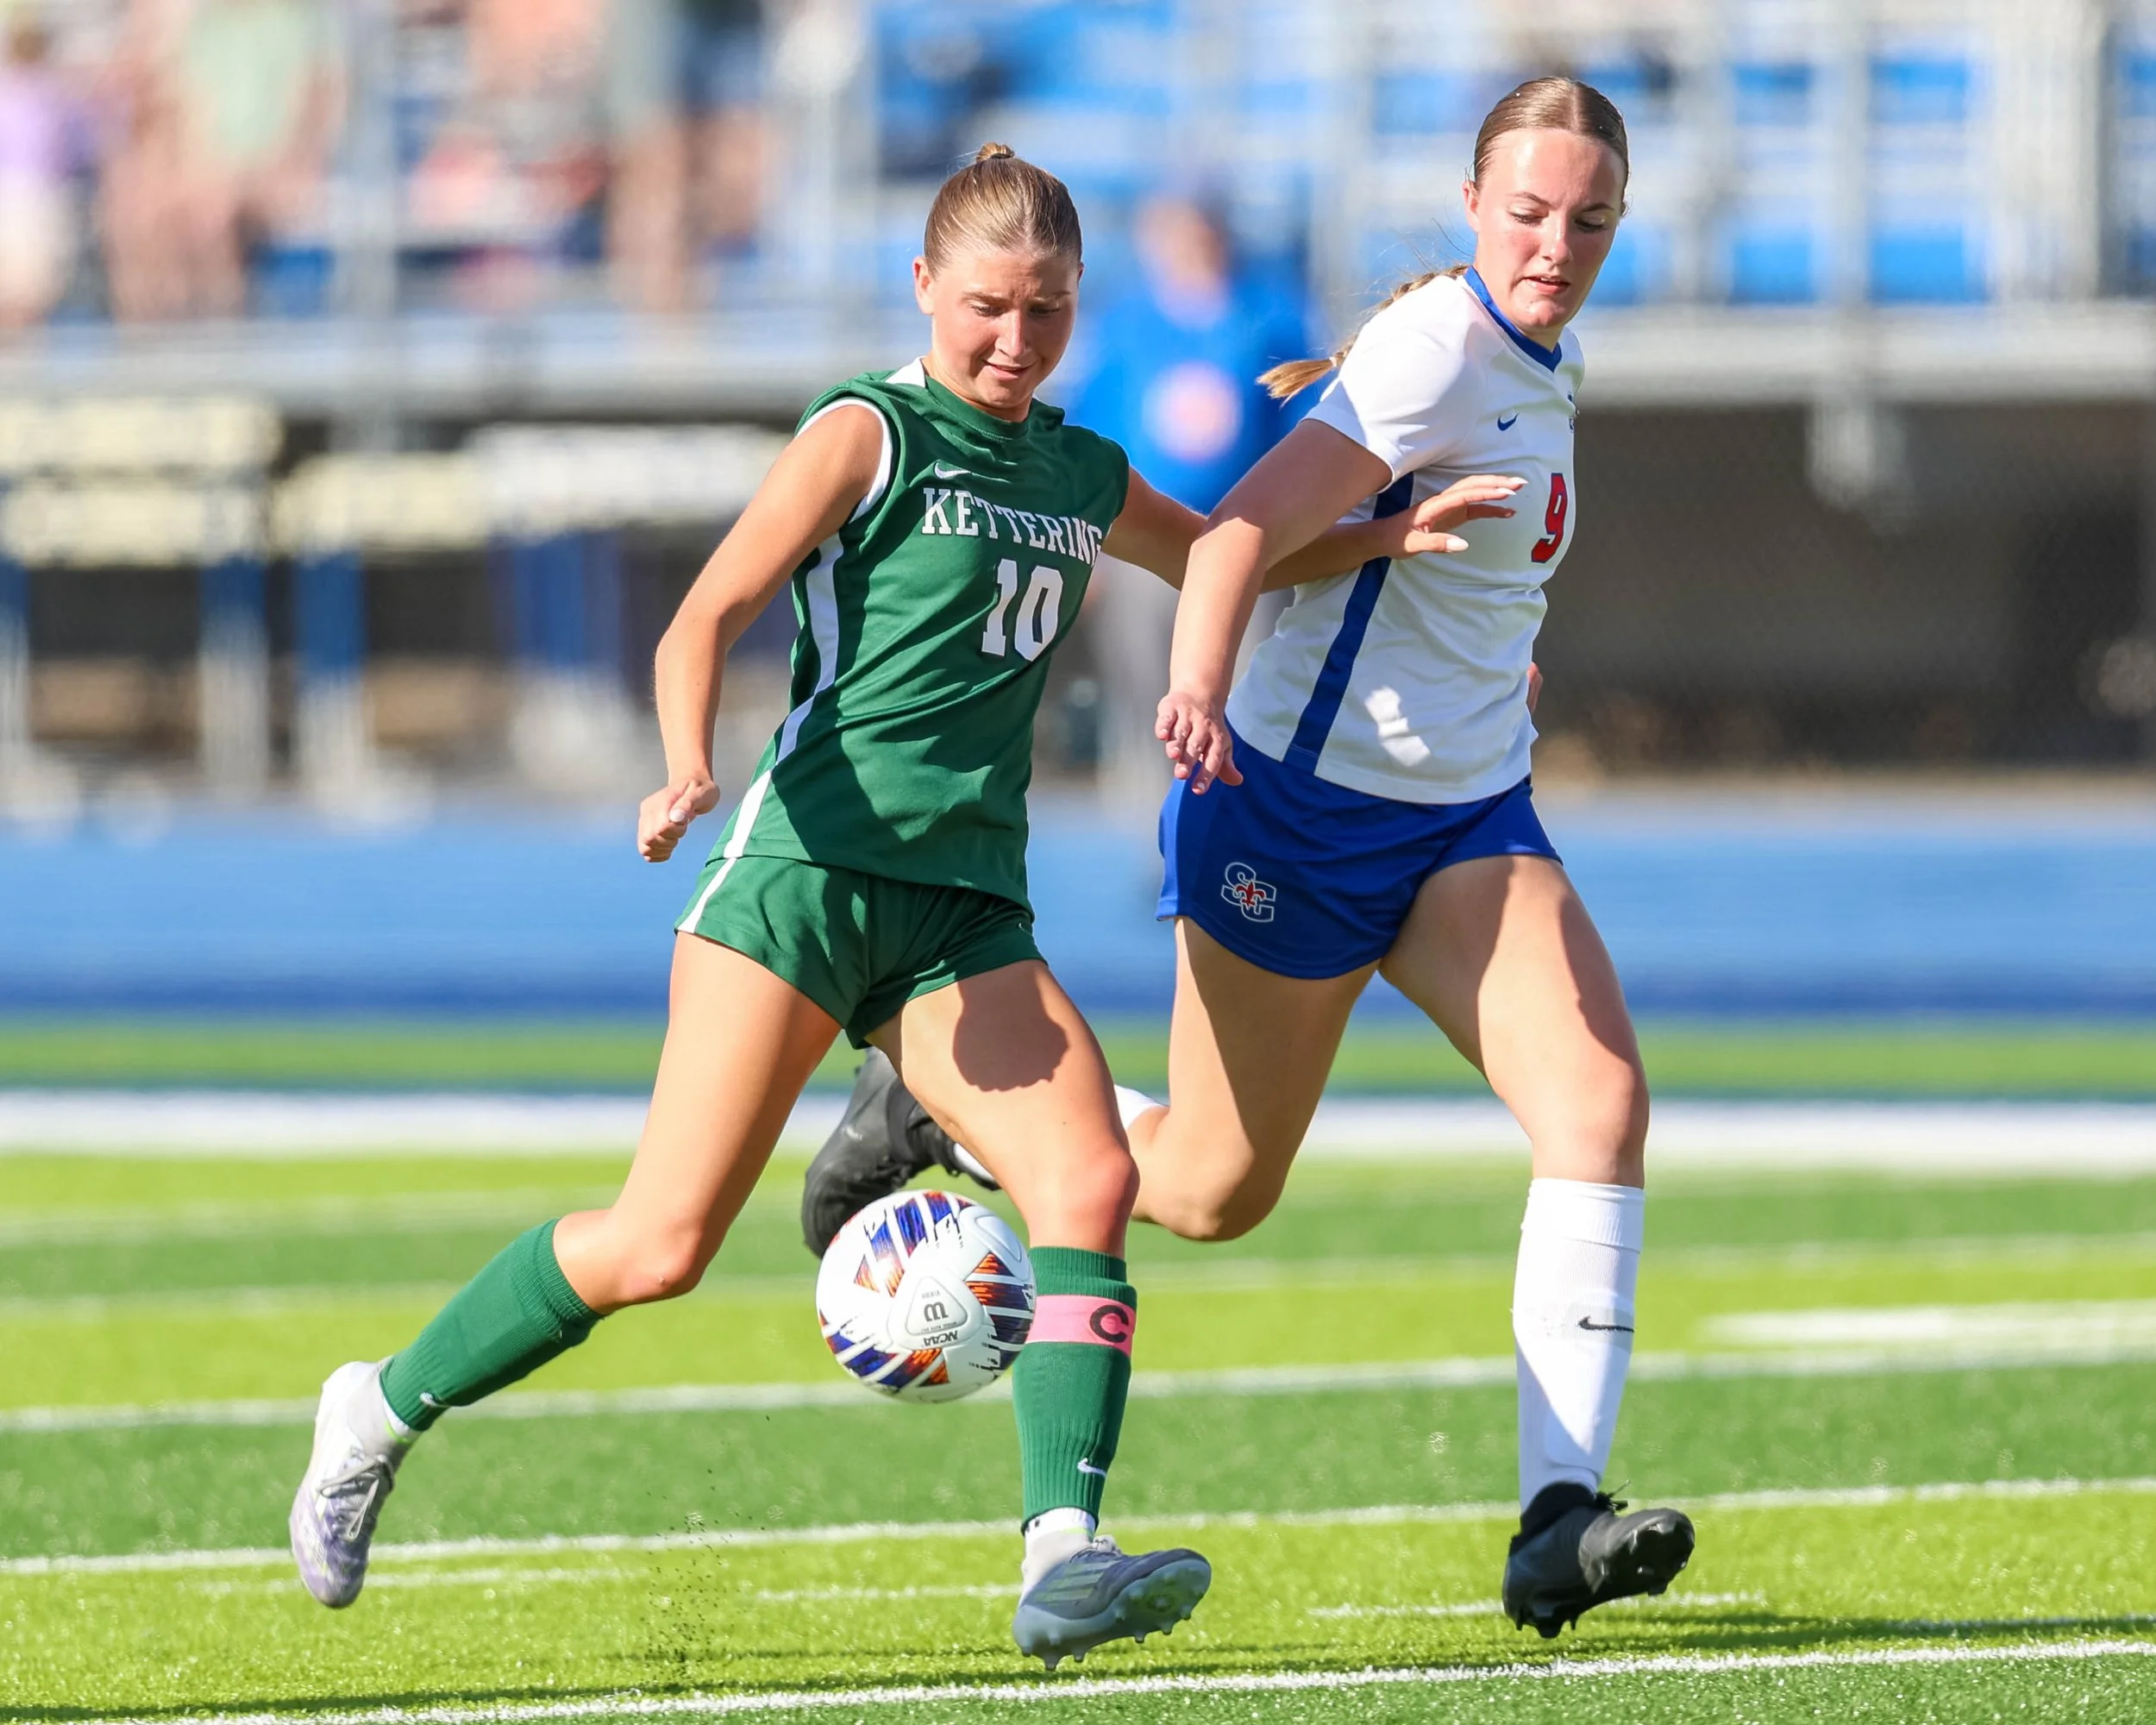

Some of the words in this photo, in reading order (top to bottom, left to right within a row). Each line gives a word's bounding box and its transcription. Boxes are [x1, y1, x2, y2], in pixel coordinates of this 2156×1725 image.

[1531, 473, 1568, 563] 9
[981, 558, 1063, 662] 10
[923, 1330, 958, 1346] NCAA
[1089, 1304, 1129, 1343] C
